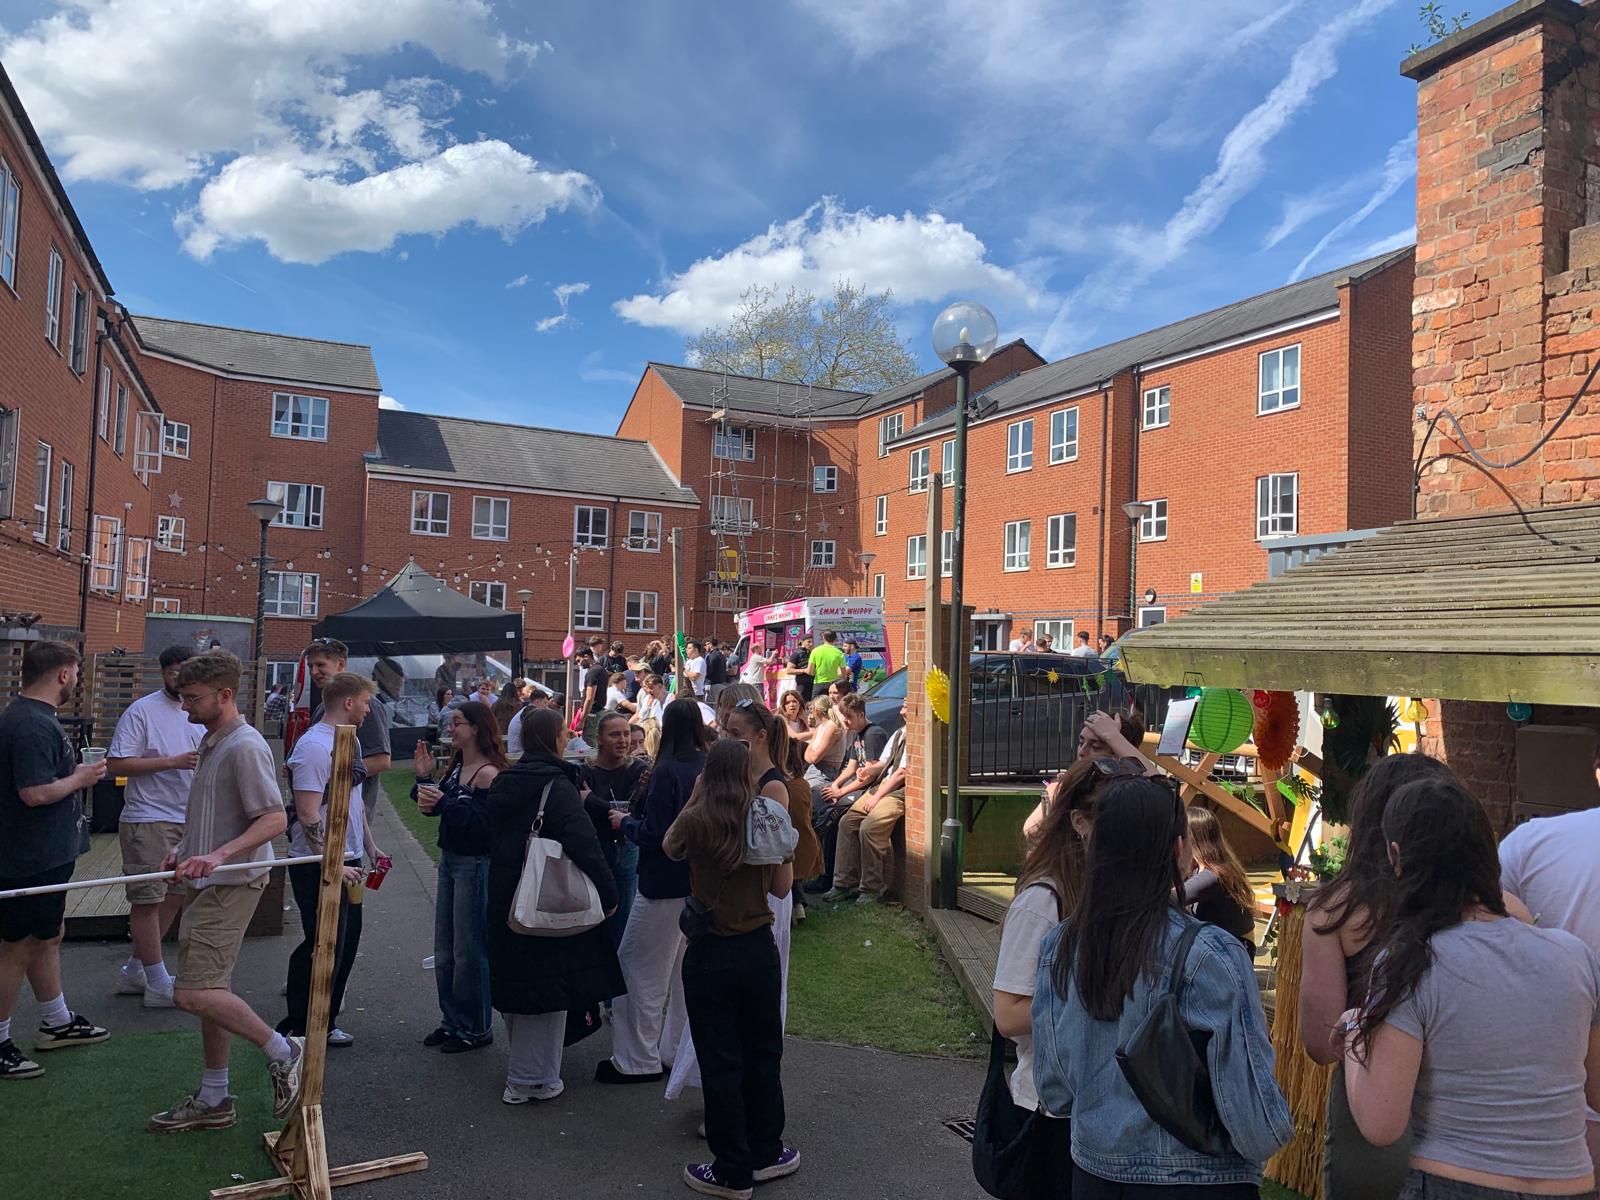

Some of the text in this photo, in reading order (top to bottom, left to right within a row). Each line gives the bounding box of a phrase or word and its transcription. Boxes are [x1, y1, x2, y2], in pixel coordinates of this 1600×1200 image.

[847, 607, 873, 615] WHIPPY
[766, 611, 792, 622] EMMA'S WHIPPY
